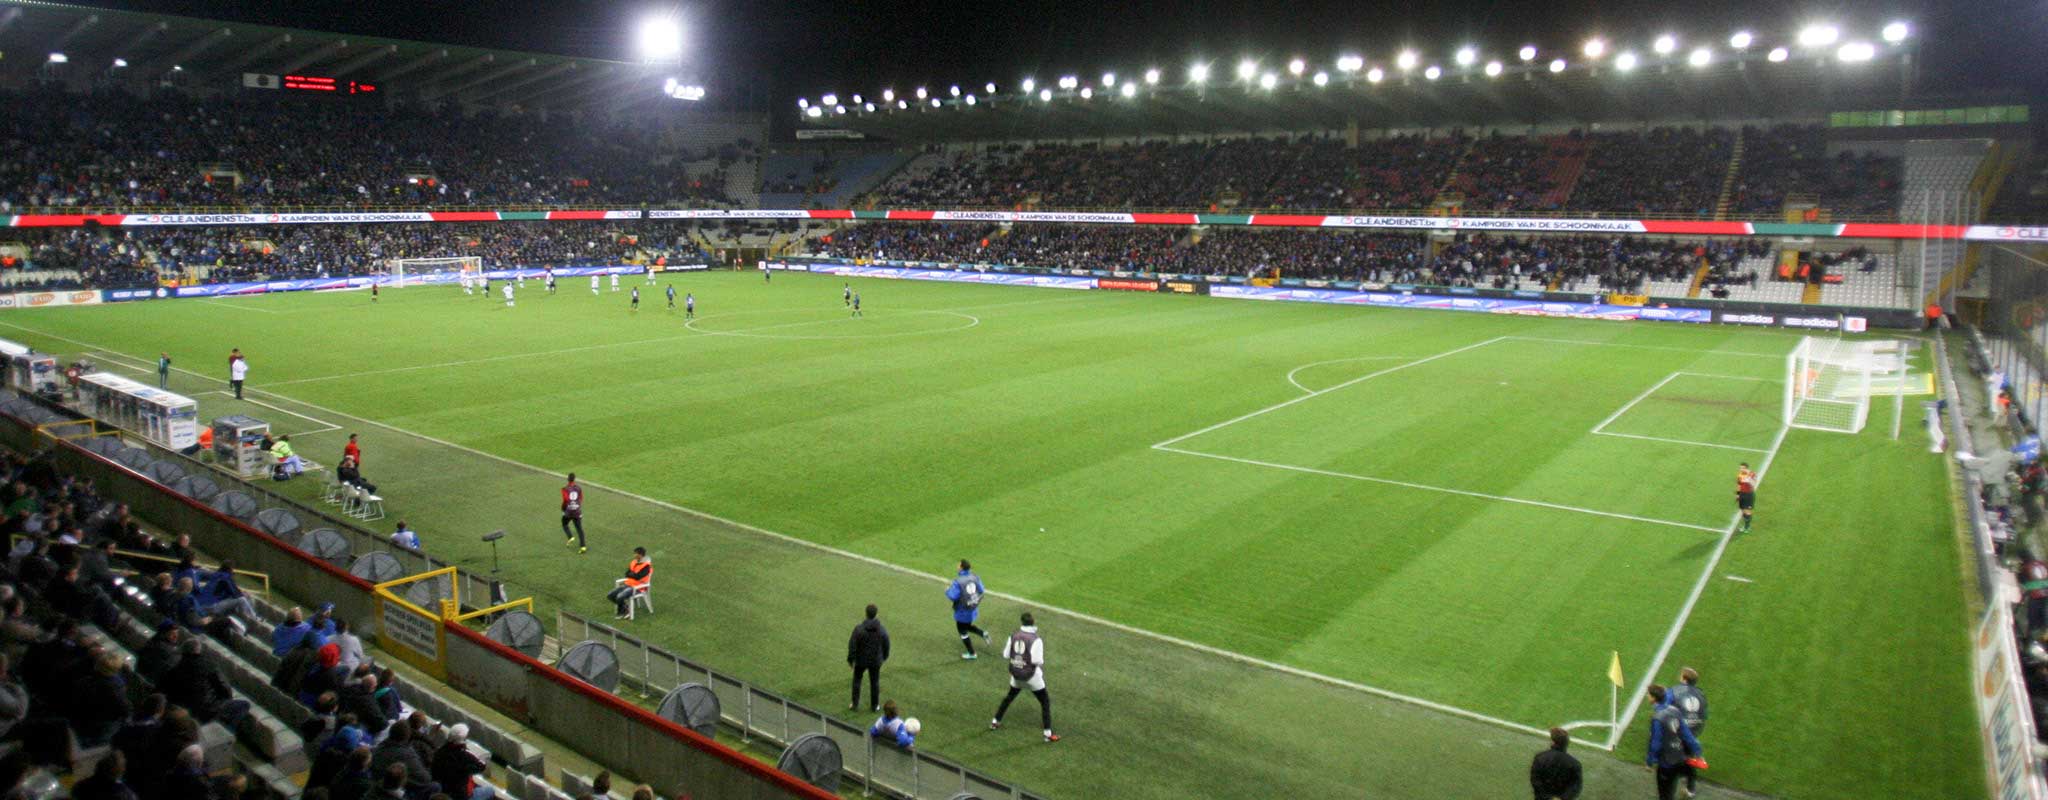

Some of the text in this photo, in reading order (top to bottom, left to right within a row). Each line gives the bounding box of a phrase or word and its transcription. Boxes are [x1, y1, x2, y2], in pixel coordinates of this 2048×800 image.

[161, 214, 255, 224] CLEANDIENST.be
[364, 213, 423, 221] SCHOONMAAK
[1354, 217, 1436, 227] CLEANDIENST.be
[1462, 220, 1513, 228] KAMPIOEN
[1553, 221, 1632, 230] SCHOONMAAK
[1740, 313, 1839, 328] adidas adidas
